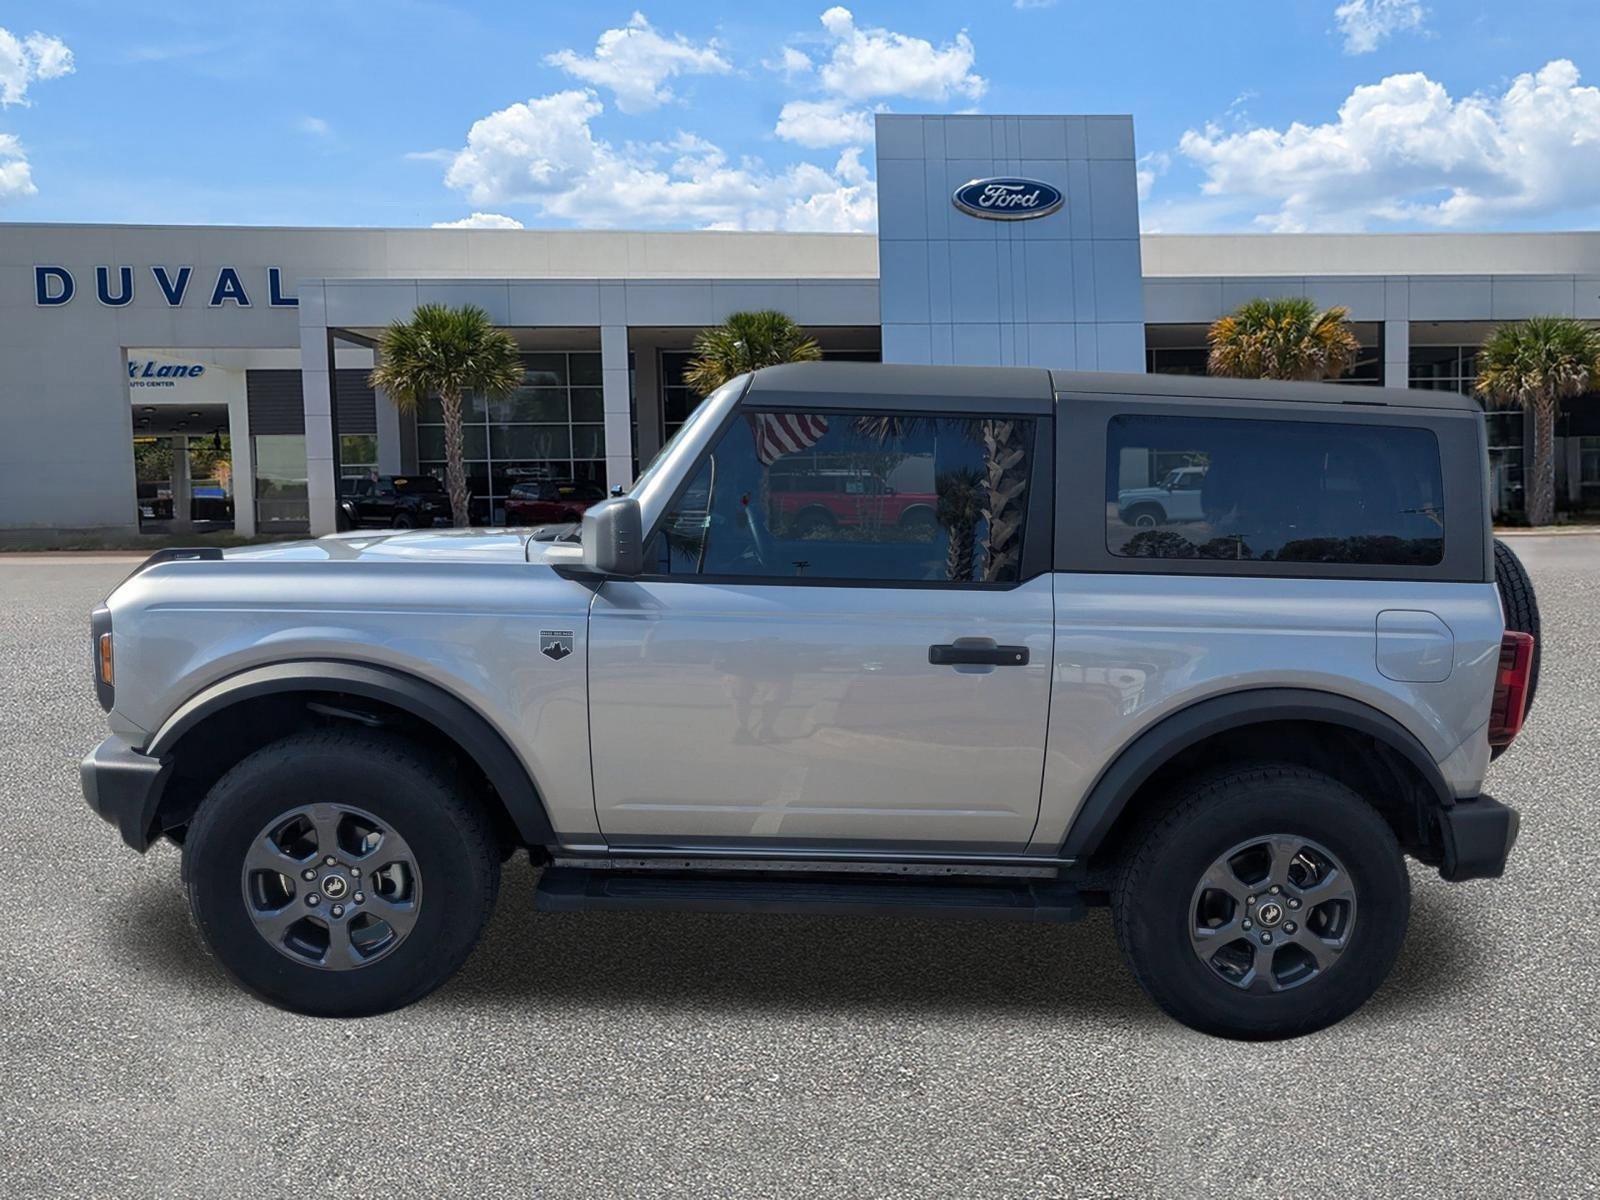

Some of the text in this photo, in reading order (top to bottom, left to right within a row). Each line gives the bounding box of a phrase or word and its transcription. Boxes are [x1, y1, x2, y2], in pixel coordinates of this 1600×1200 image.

[978, 184, 1040, 207] Ford
[33, 265, 299, 308] DUVAL
[142, 361, 205, 378] Lane
